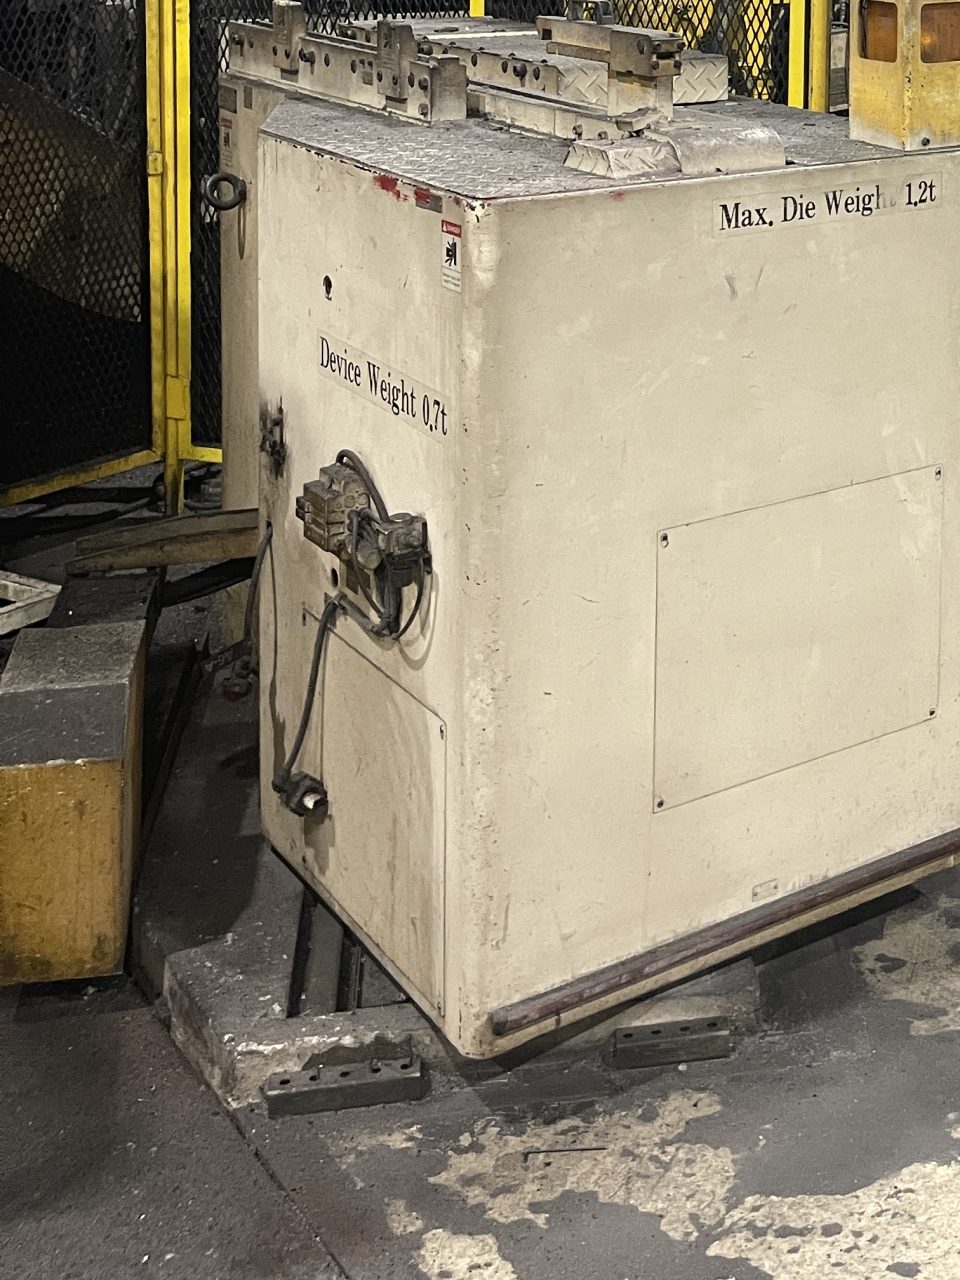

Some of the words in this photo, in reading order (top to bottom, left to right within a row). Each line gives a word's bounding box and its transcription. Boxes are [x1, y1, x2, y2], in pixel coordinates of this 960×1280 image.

[719, 202, 774, 231] Max.
[781, 194, 816, 223] Die
[905, 179, 937, 207] 1.2t
[320, 336, 361, 387] Device
[367, 361, 417, 418] Weight
[422, 394, 448, 436] 0.7t
